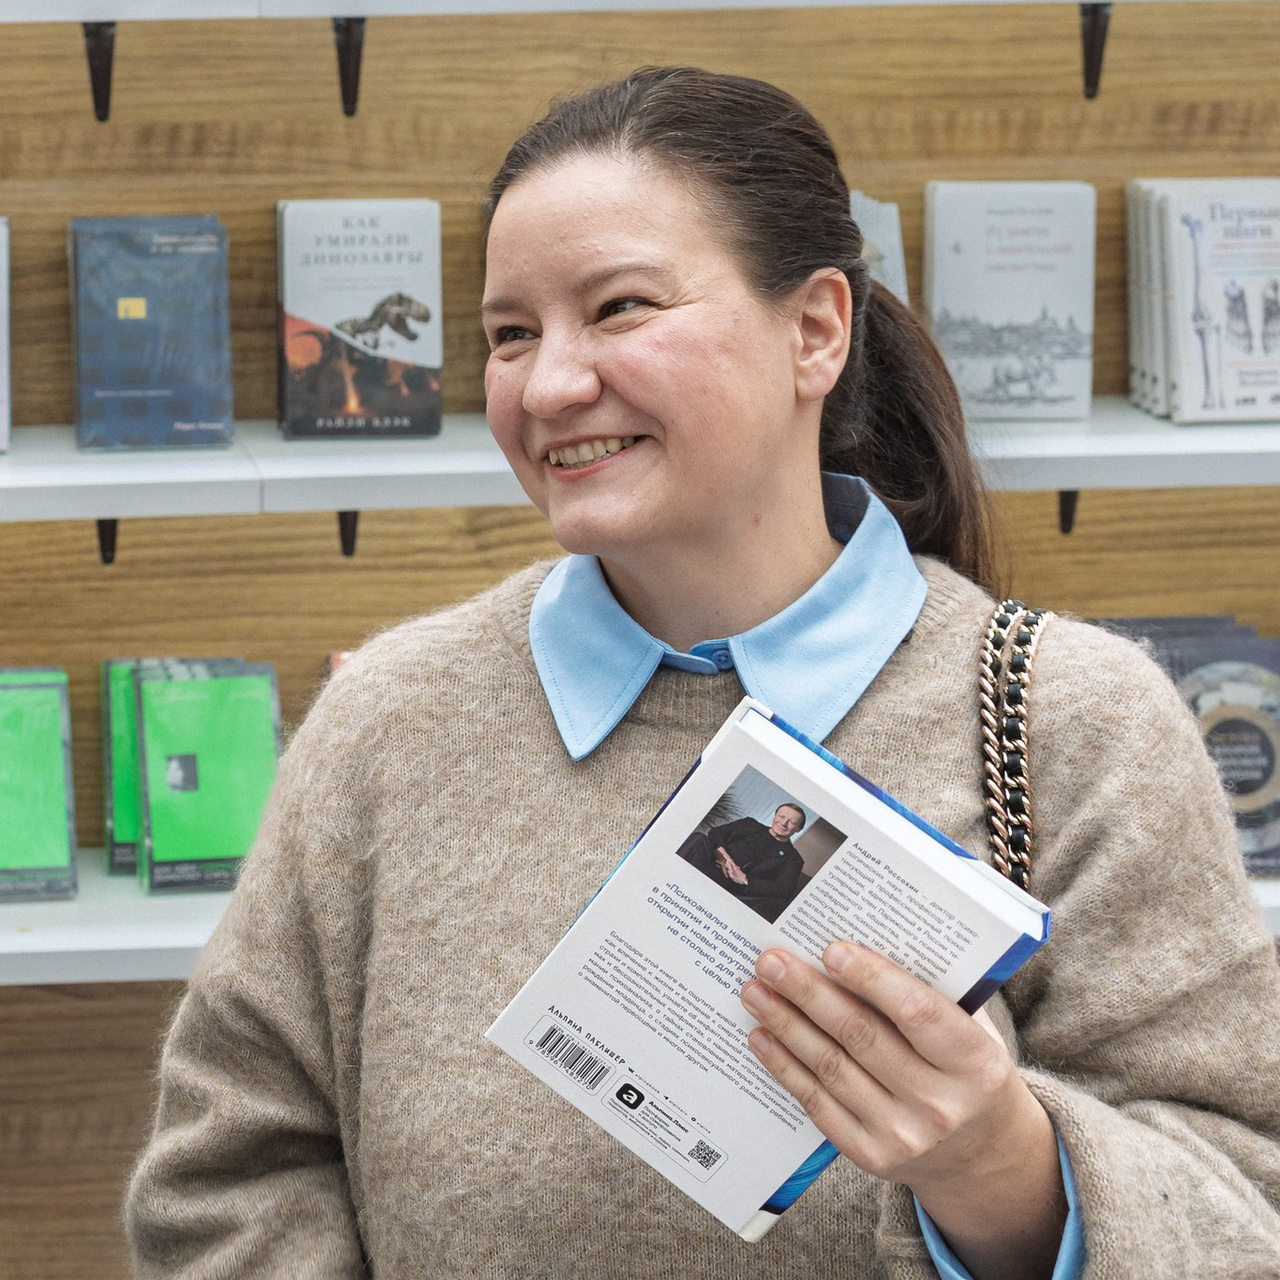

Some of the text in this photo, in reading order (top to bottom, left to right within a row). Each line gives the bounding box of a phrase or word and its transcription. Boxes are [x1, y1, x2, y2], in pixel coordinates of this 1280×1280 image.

[850, 841, 882, 866] Андрей
[882, 864, 919, 894] Россохин
[646, 896, 718, 950] открытии новых
[658, 890, 703, 926] принятии
[665, 881, 728, 930] «Психоанализ
[875, 884, 942, 934] профессиональный
[906, 894, 944, 924] профессор
[608, 930, 644, 958] Благодаря
[666, 924, 734, 978] не столько для
[702, 965, 730, 989] целью
[546, 1004, 584, 1034] АЛЬПИНА
[584, 1032, 626, 1066] ПАБЛИШЕР
